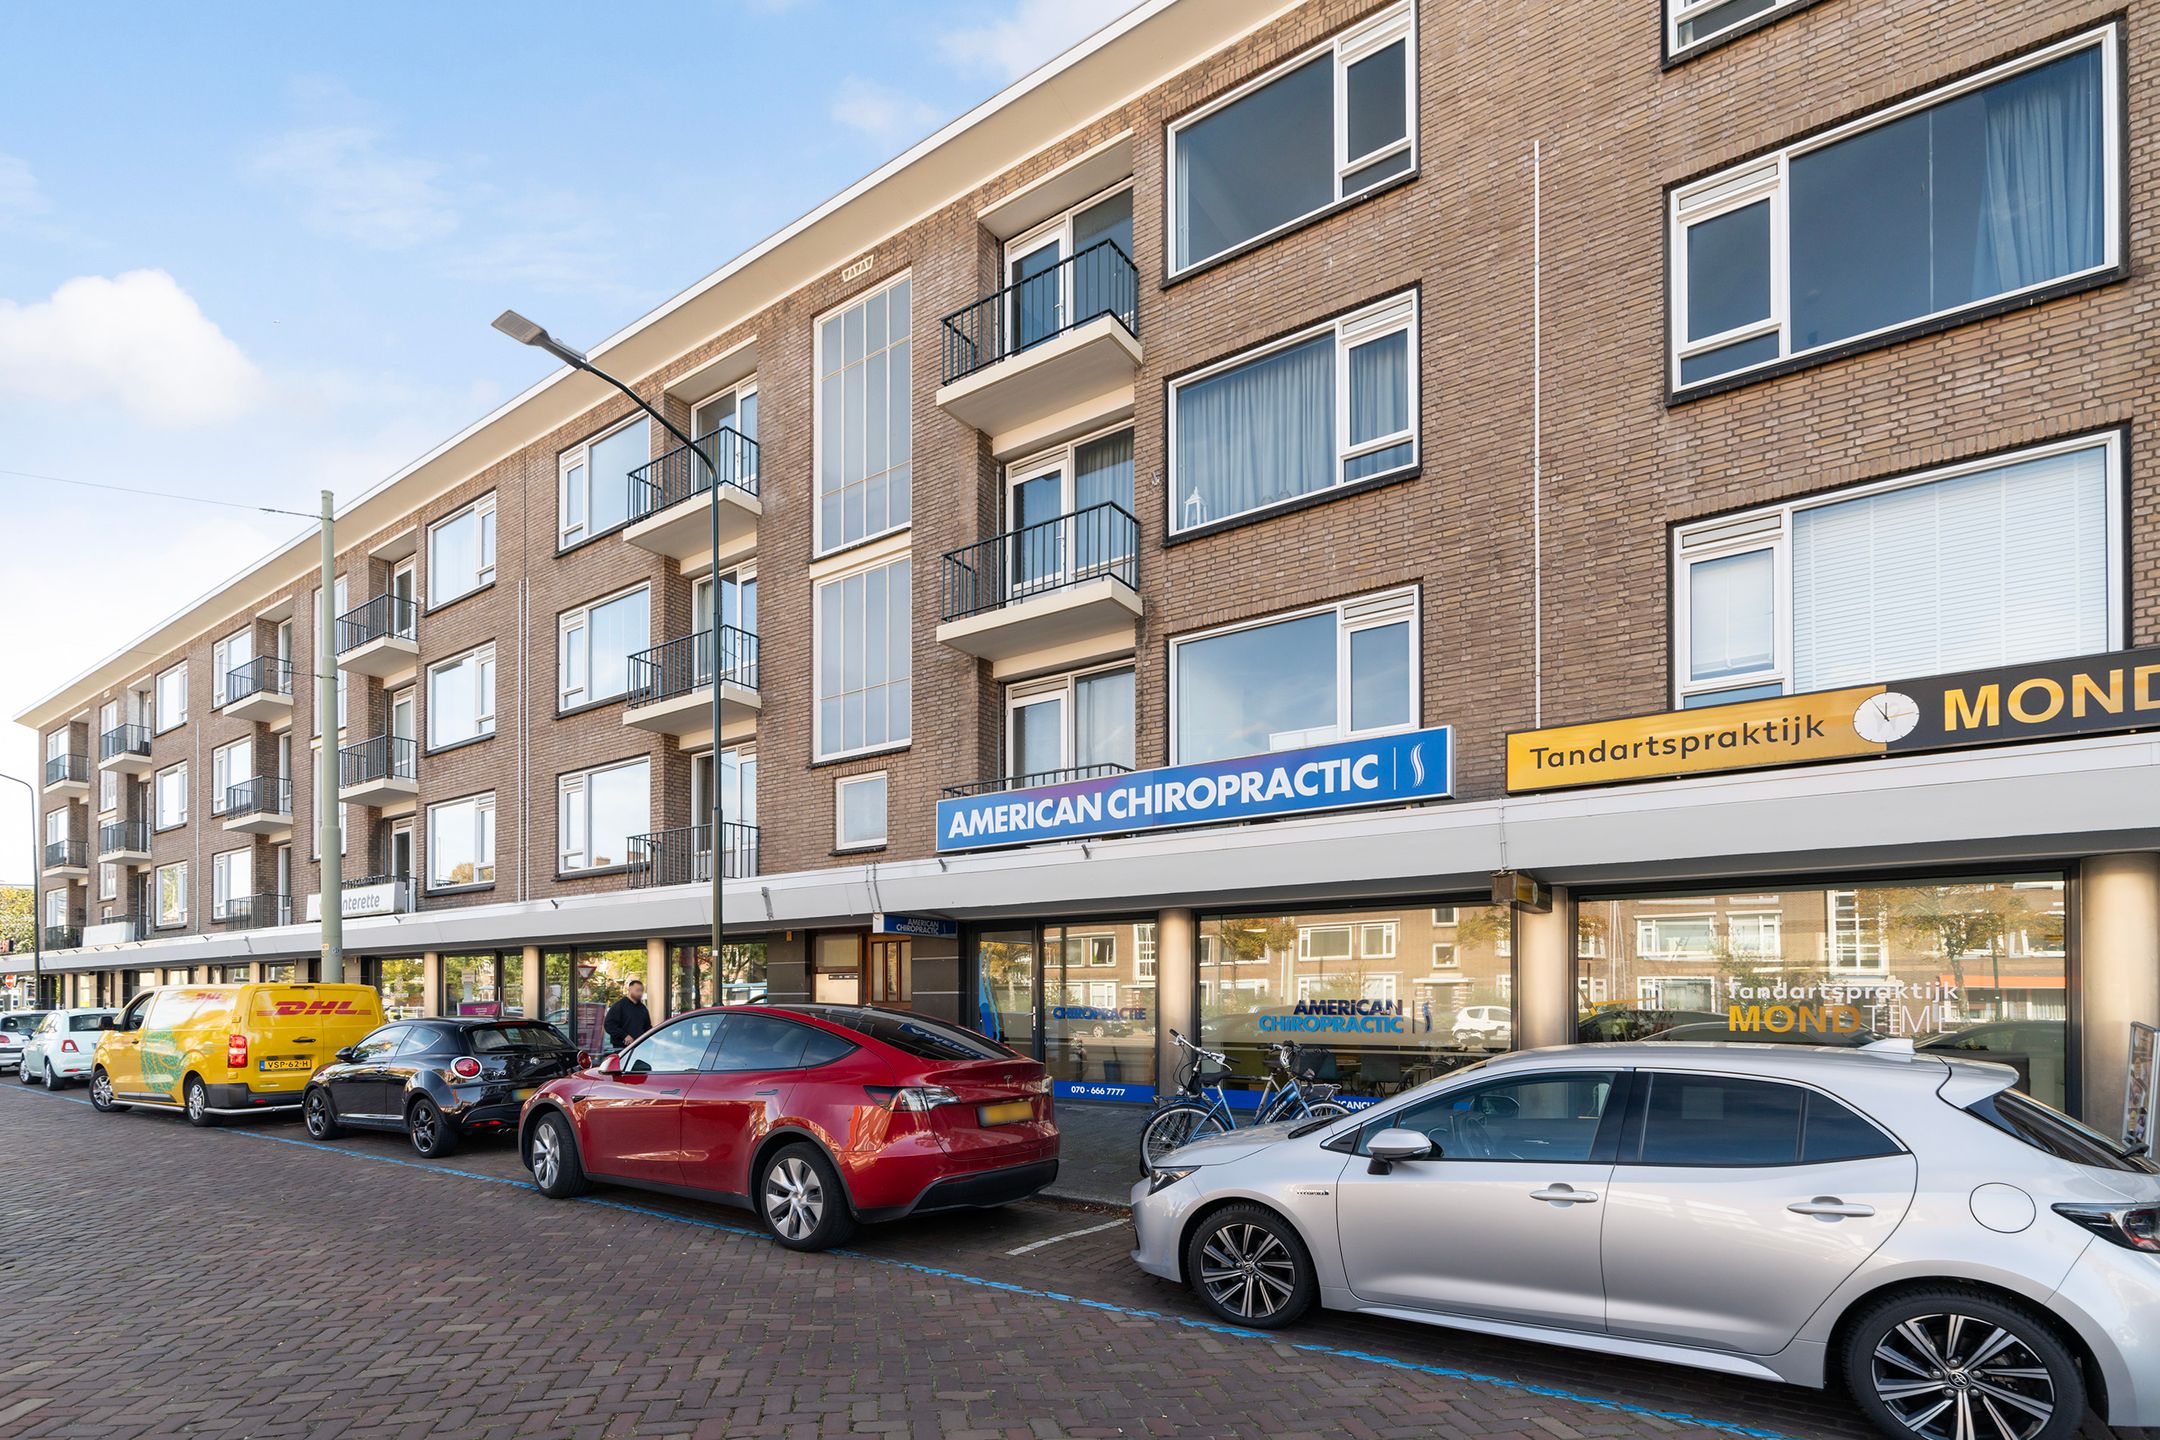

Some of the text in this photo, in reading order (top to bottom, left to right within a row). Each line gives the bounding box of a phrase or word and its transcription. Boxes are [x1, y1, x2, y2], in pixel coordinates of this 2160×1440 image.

[1529, 714, 1826, 770] Tandartspraktijk
[948, 754, 1379, 839] AMERICAN CHIROPRACTIC
[342, 893, 380, 911] nterette
[896, 923, 939, 935] CHIROPRACTIC
[907, 918, 939, 928] AMERICAN
[1728, 981, 1959, 1005] Tandartspraktijk
[274, 1001, 358, 1016] DHL
[1293, 999, 1404, 1016] AMERICAN
[1258, 1015, 1405, 1034] CHIROPRACTIC
[1728, 1004, 1959, 1034] MONDTIME
[1070, 1085, 1086, 1094] 070
[1090, 1086, 1105, 1095] 666
[1106, 1088, 1126, 1096] 7777
